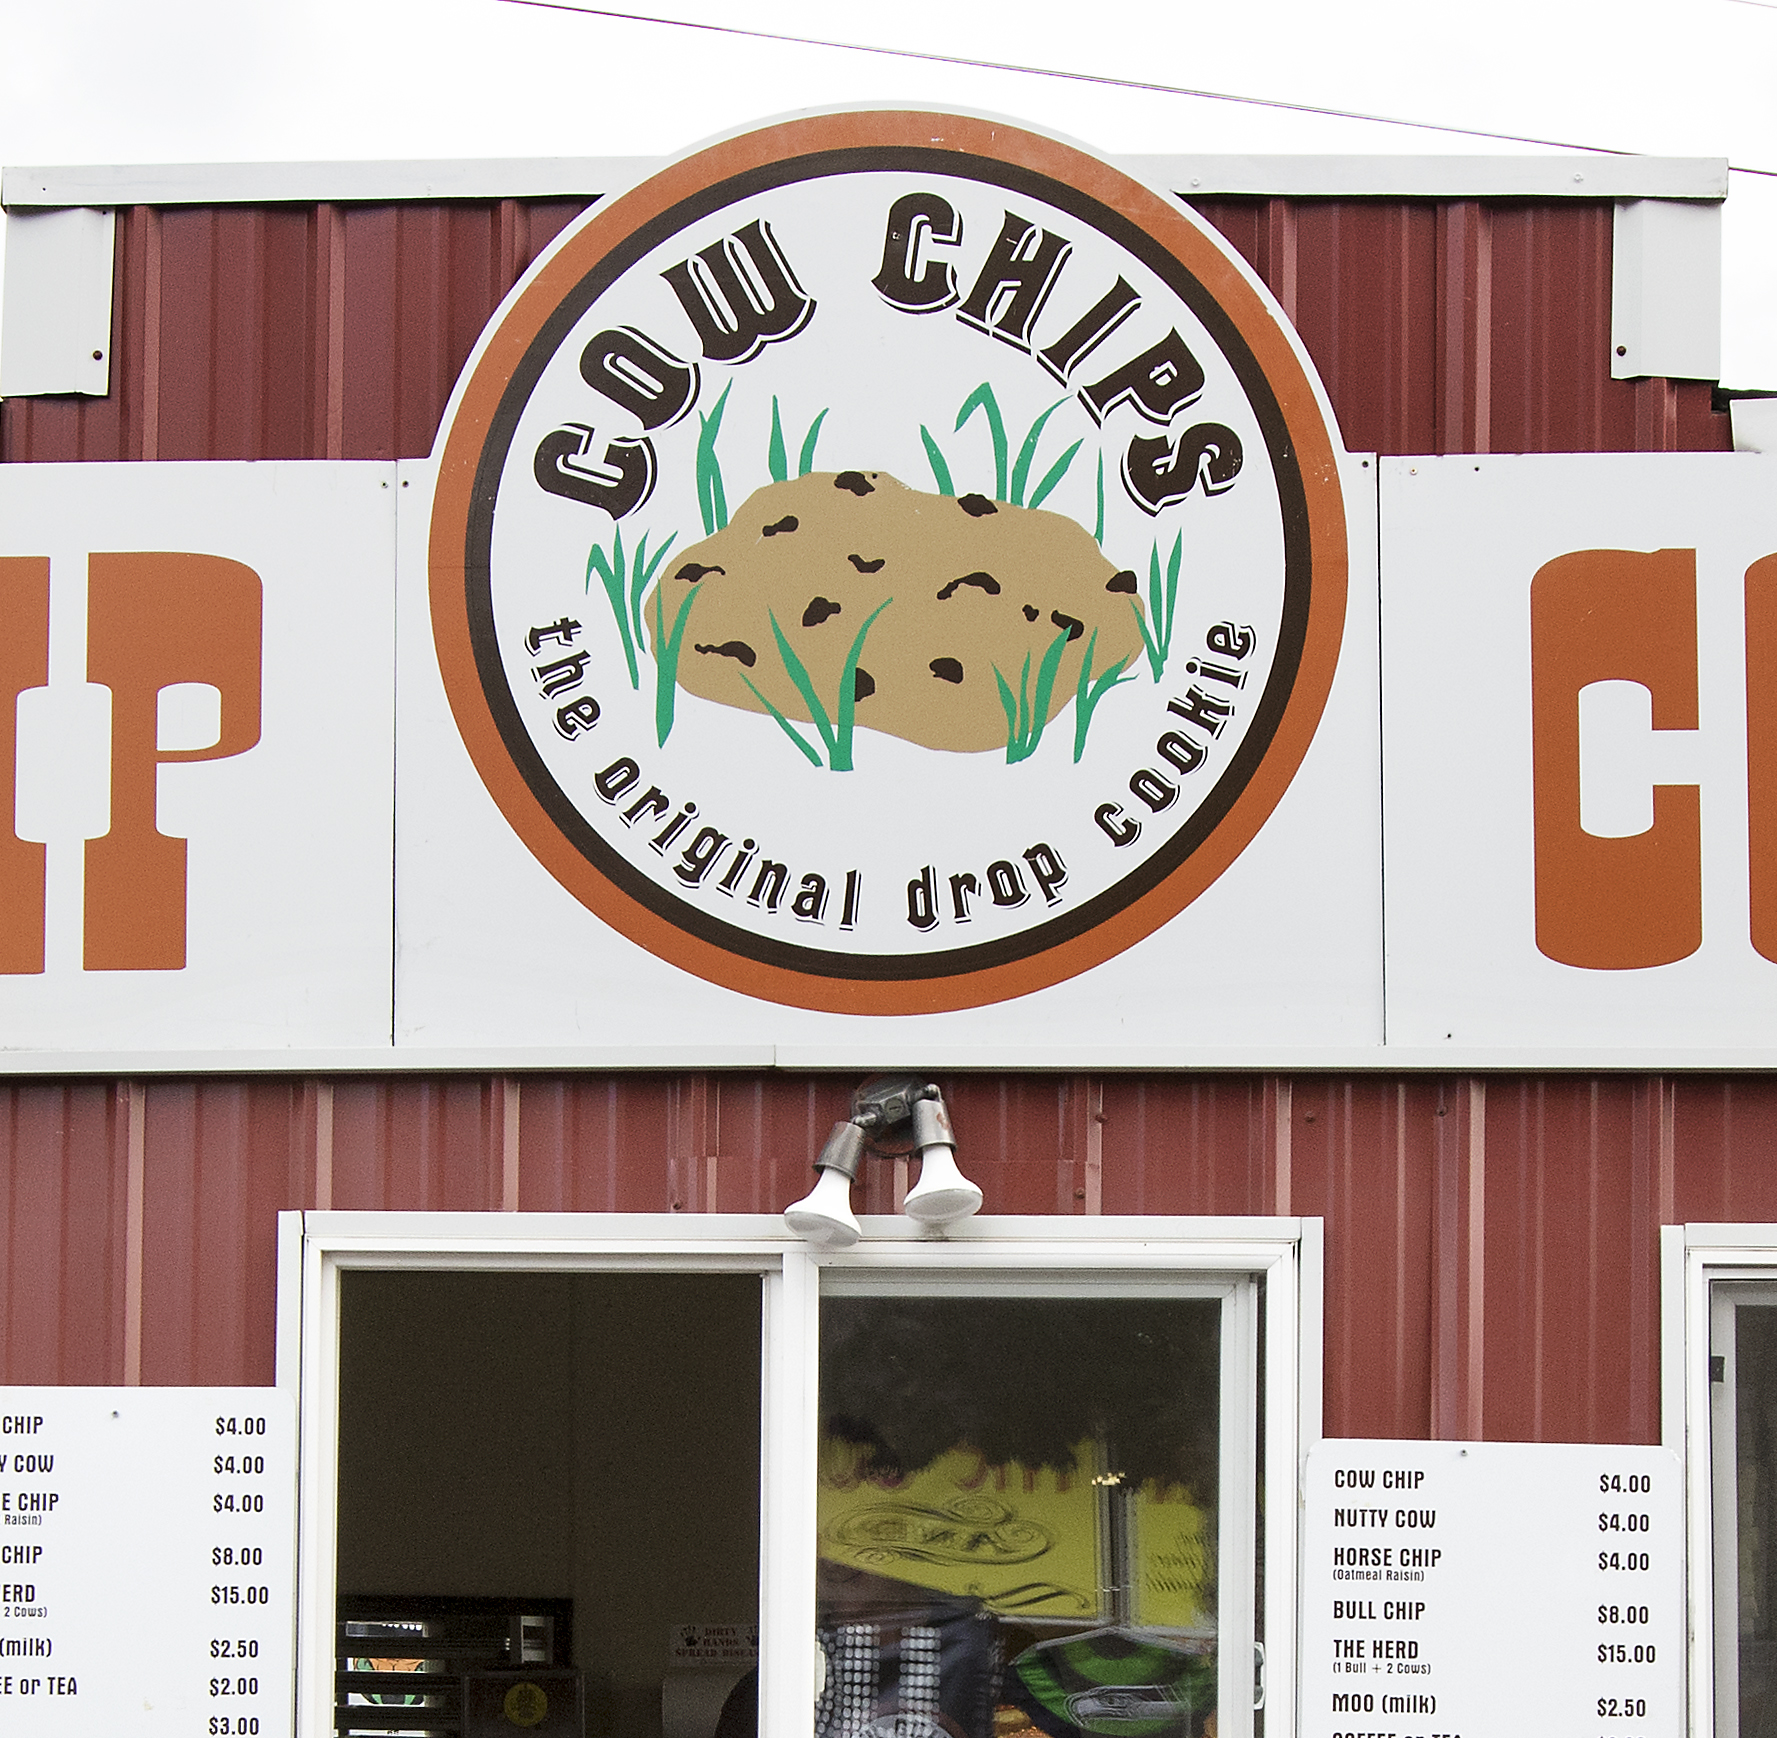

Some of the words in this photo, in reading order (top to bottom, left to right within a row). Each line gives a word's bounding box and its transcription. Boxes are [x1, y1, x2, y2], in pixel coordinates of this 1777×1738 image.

[533, 218, 818, 522] COW
[872, 191, 1244, 518] CHIPS
[524, 615, 601, 742] the
[595, 755, 861, 931] original
[907, 839, 1071, 933] drop
[1099, 620, 1258, 852] cookie
[3, 1416, 43, 1433] CHIP
[216, 1417, 265, 1435] $4.00
[15, 1455, 53, 1472] COW
[214, 1456, 263, 1474] $4.00
[1335, 1470, 1374, 1488] COW
[1383, 1471, 1424, 1489] CHIP
[1600, 1474, 1650, 1493] $4.00
[19, 1493, 58, 1511] CHIP
[214, 1495, 263, 1512] $4.00
[1335, 1509, 1387, 1527] NUTTY
[1396, 1510, 1435, 1528] COW
[1599, 1513, 1648, 1532] $4.00
[2, 1546, 42, 1563] CHIP
[213, 1547, 262, 1565] $8.00
[1335, 1548, 1391, 1567] HORSE
[1400, 1549, 1441, 1567] CHIP
[1599, 1552, 1648, 1570] $4.00
[1333, 1569, 1381, 1580] (Oatmeal
[1386, 1570, 1424, 1582] Raisin)
[212, 1586, 268, 1604] $15.00
[1334, 1601, 1376, 1619] BULL
[1384, 1602, 1425, 1620] CHIP
[1599, 1605, 1648, 1624] $8.00
[0, 1638, 51, 1657] (milk)
[211, 1640, 258, 1658] $2.50
[1334, 1640, 1364, 1658] THE
[1373, 1640, 1418, 1658] HERD
[1598, 1644, 1655, 1663] $15.00
[1333, 1662, 1341, 1673] (1
[1346, 1662, 1366, 1673] Bull
[1372, 1664, 1381, 1673] +
[1387, 1663, 1393, 1674] 2
[1397, 1663, 1431, 1675] Cows)
[21, 1679, 40, 1694] or
[48, 1677, 76, 1695] TEA
[210, 1678, 257, 1697] $2.00
[1333, 1694, 1373, 1712] MOO
[1383, 1695, 1435, 1714] (milk)
[1598, 1698, 1645, 1717] $2.50
[209, 1717, 258, 1735] $3.00
